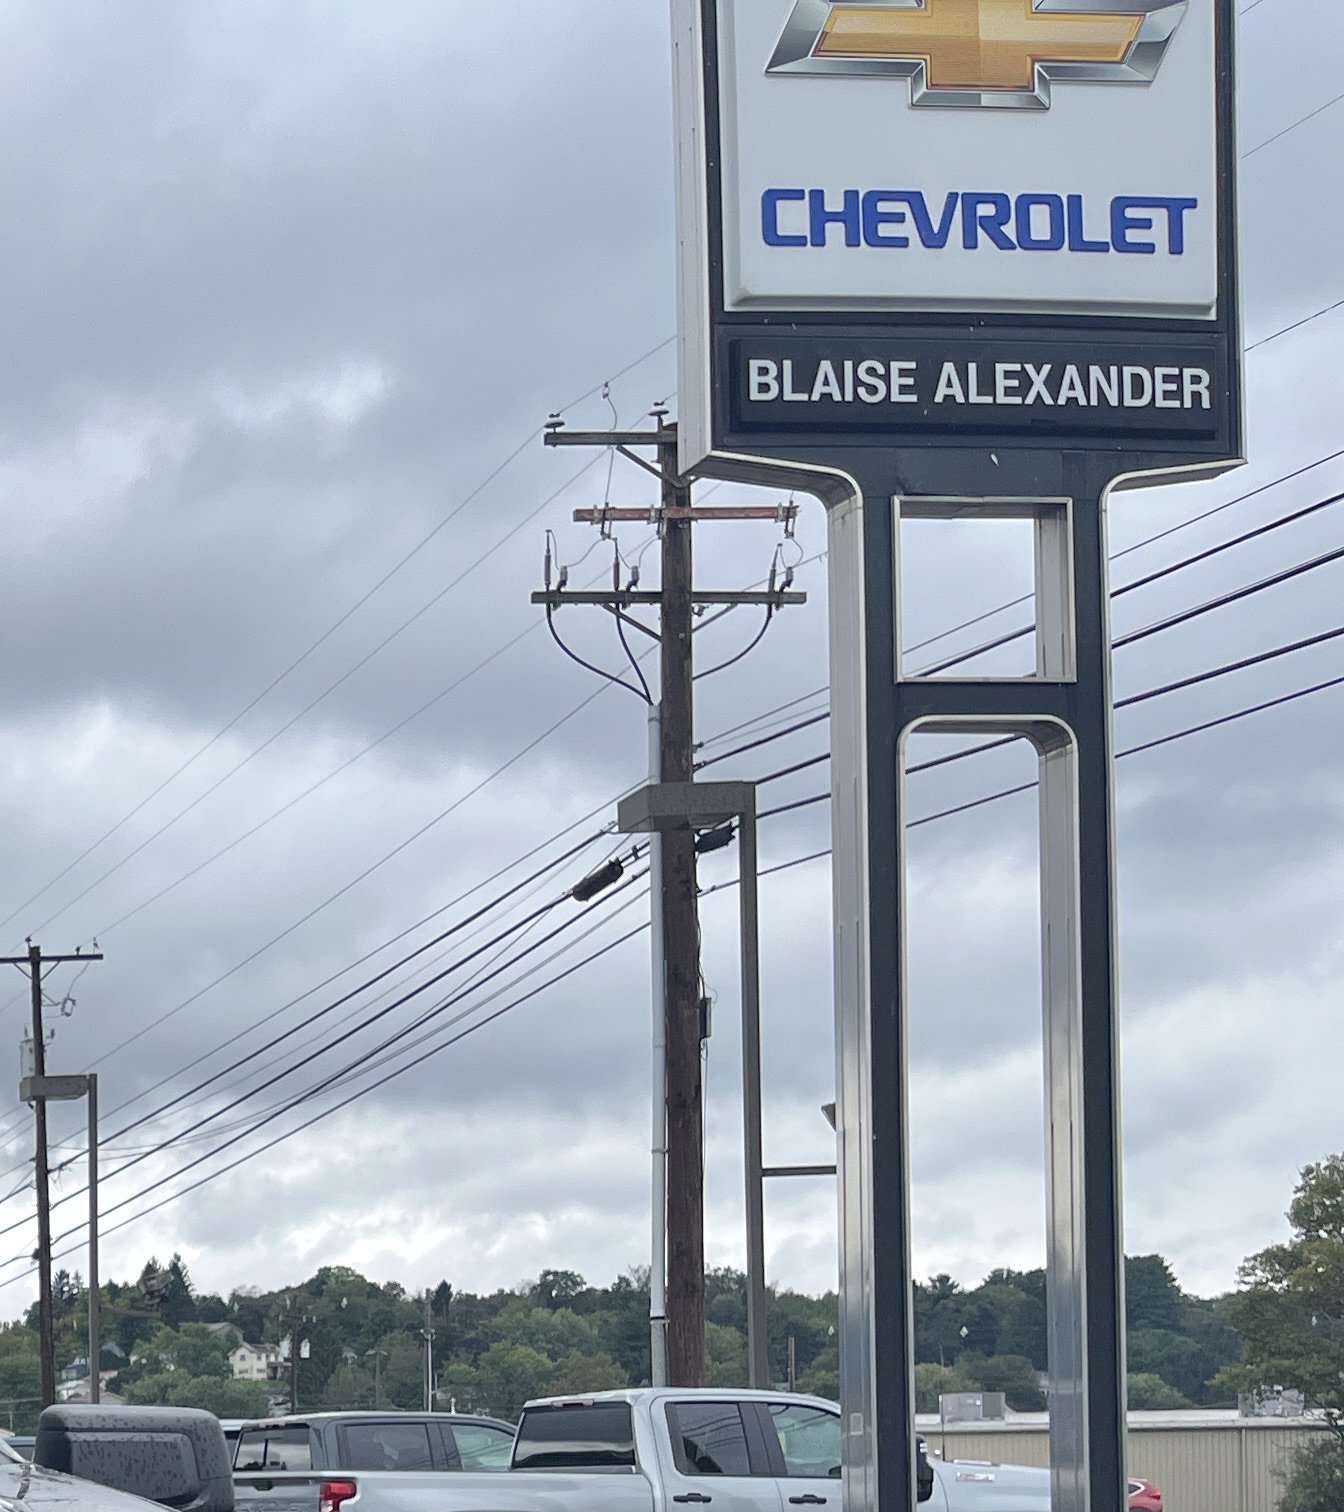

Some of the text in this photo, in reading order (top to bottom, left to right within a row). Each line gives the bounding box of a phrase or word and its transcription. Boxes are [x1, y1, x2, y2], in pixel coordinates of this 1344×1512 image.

[761, 188, 1199, 255] CHEVROLET
[748, 359, 1212, 410] BLAISE ALEXANDER
